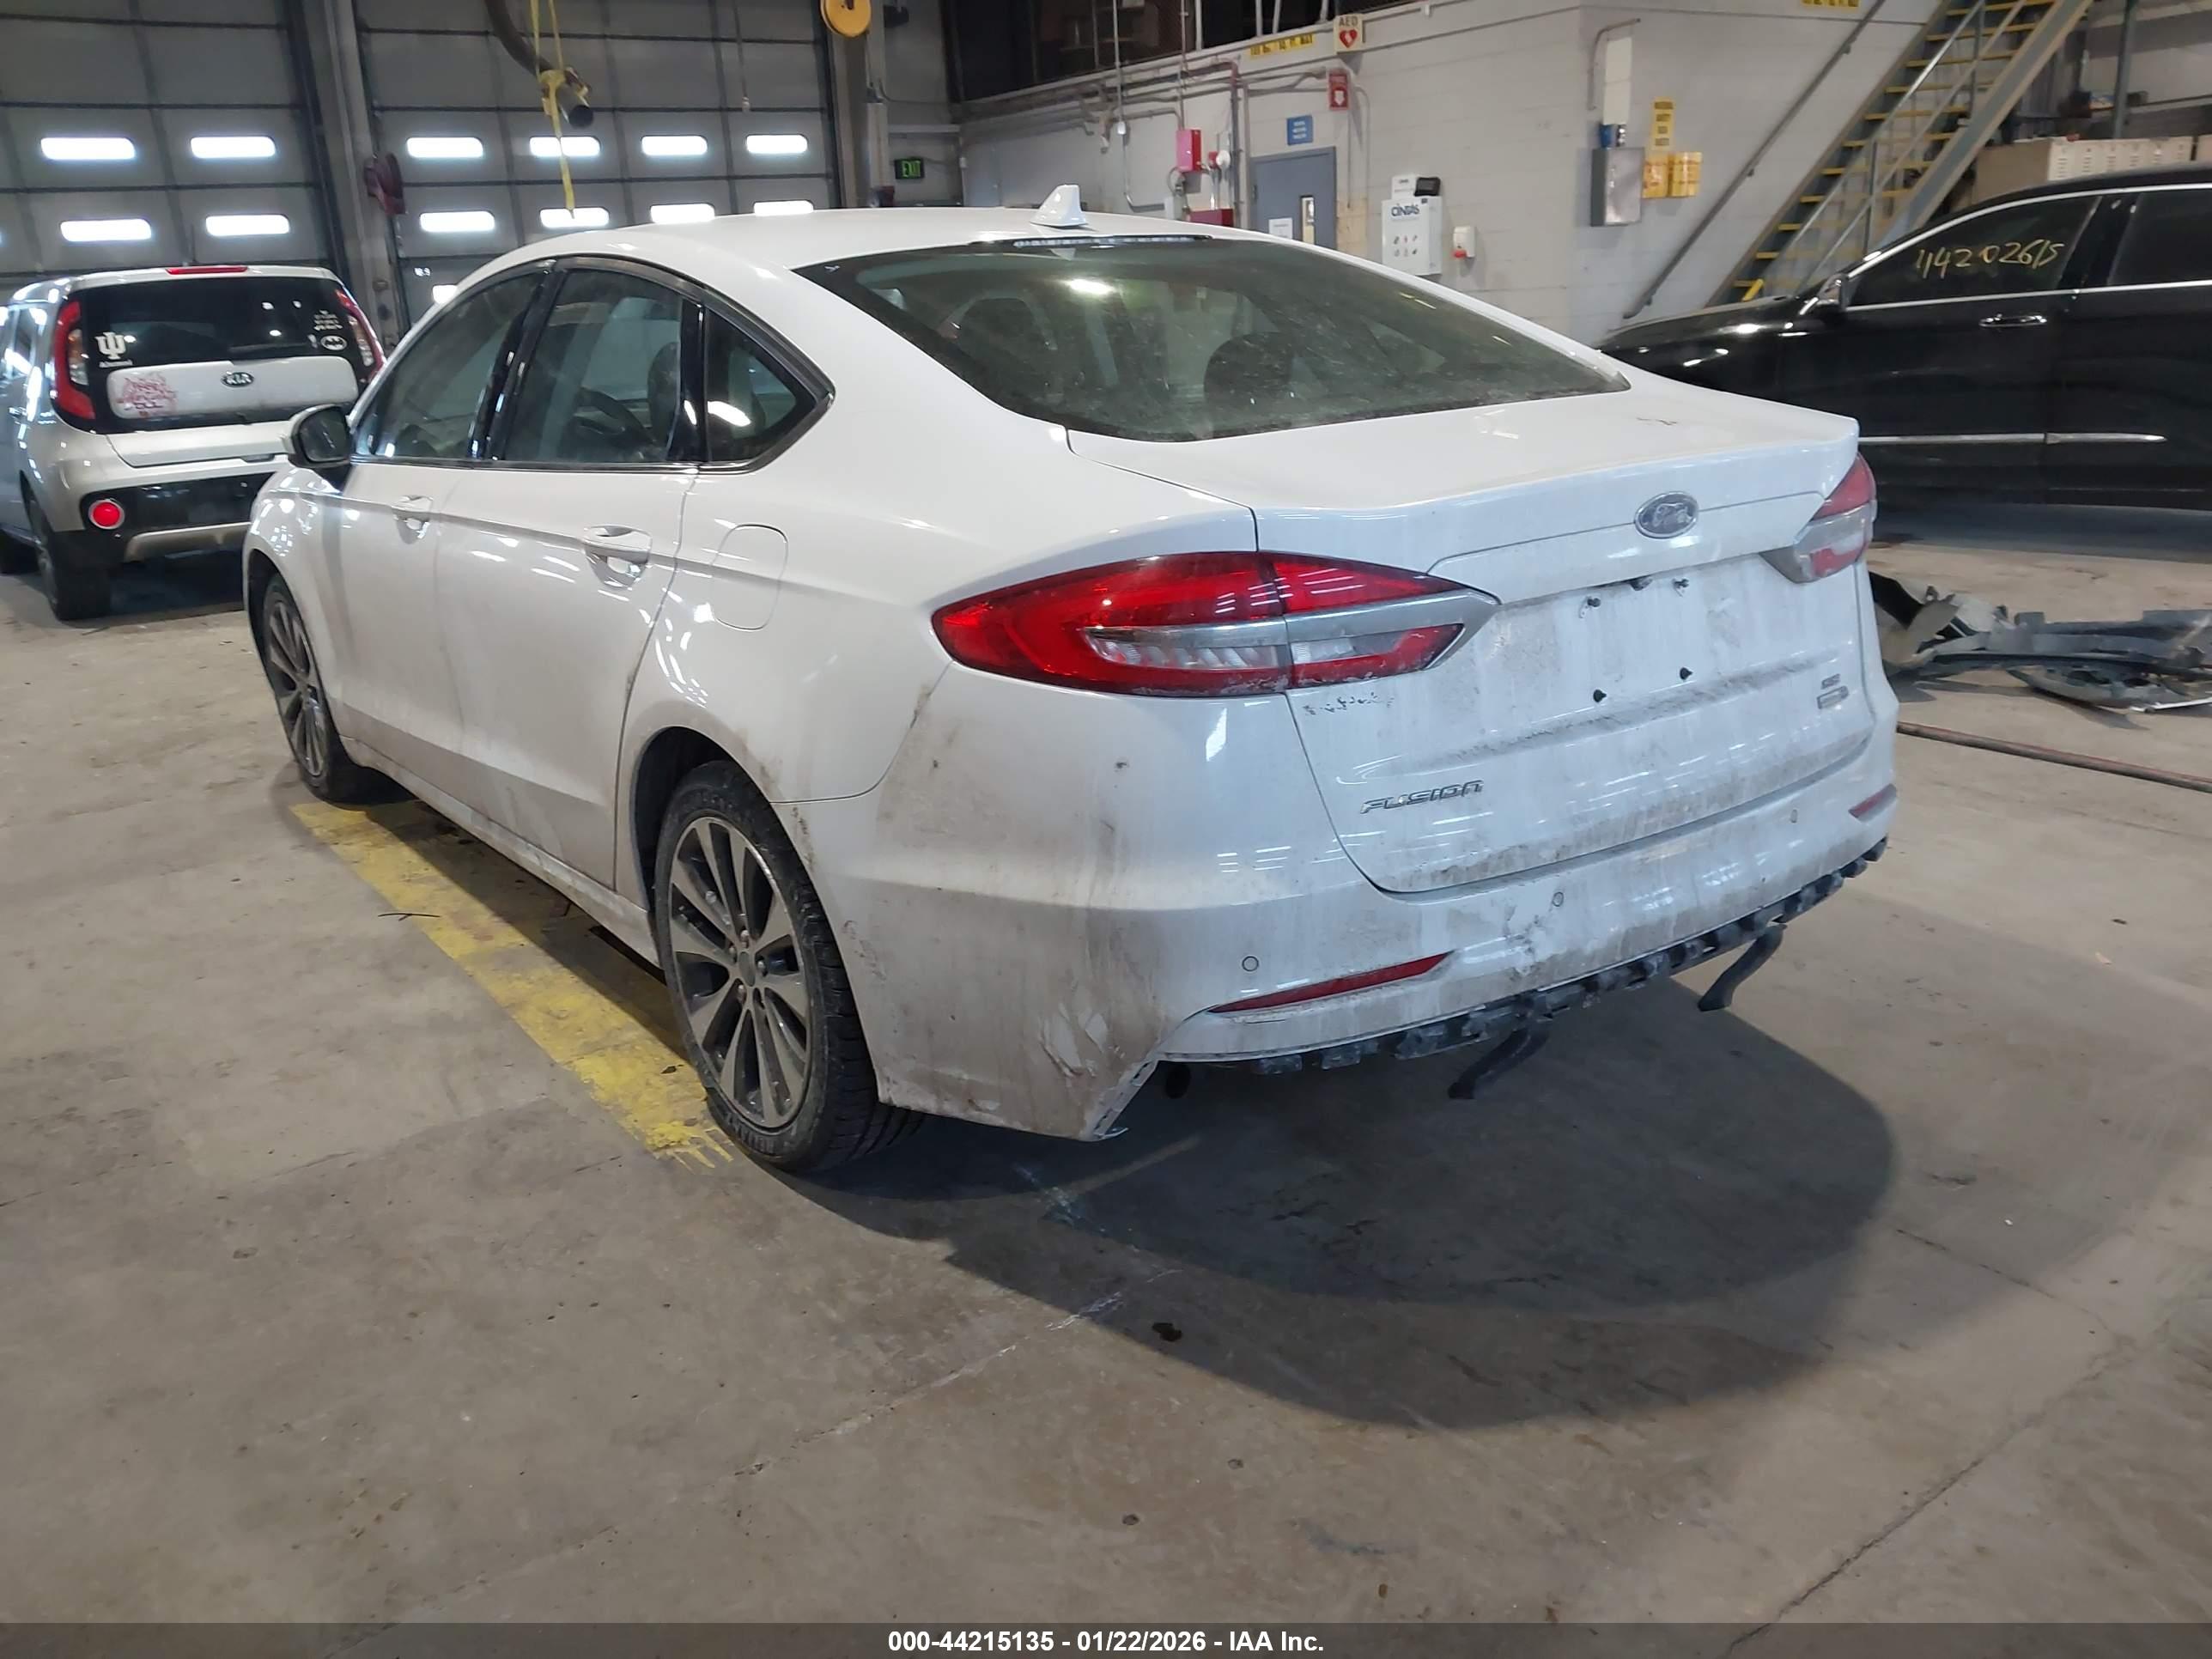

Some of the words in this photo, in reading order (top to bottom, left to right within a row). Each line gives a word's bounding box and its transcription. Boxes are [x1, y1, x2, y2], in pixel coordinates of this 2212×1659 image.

[1339, 15, 1358, 27] AED
[902, 160, 921, 178] EXIT
[1359, 779, 1485, 815] FUSION
